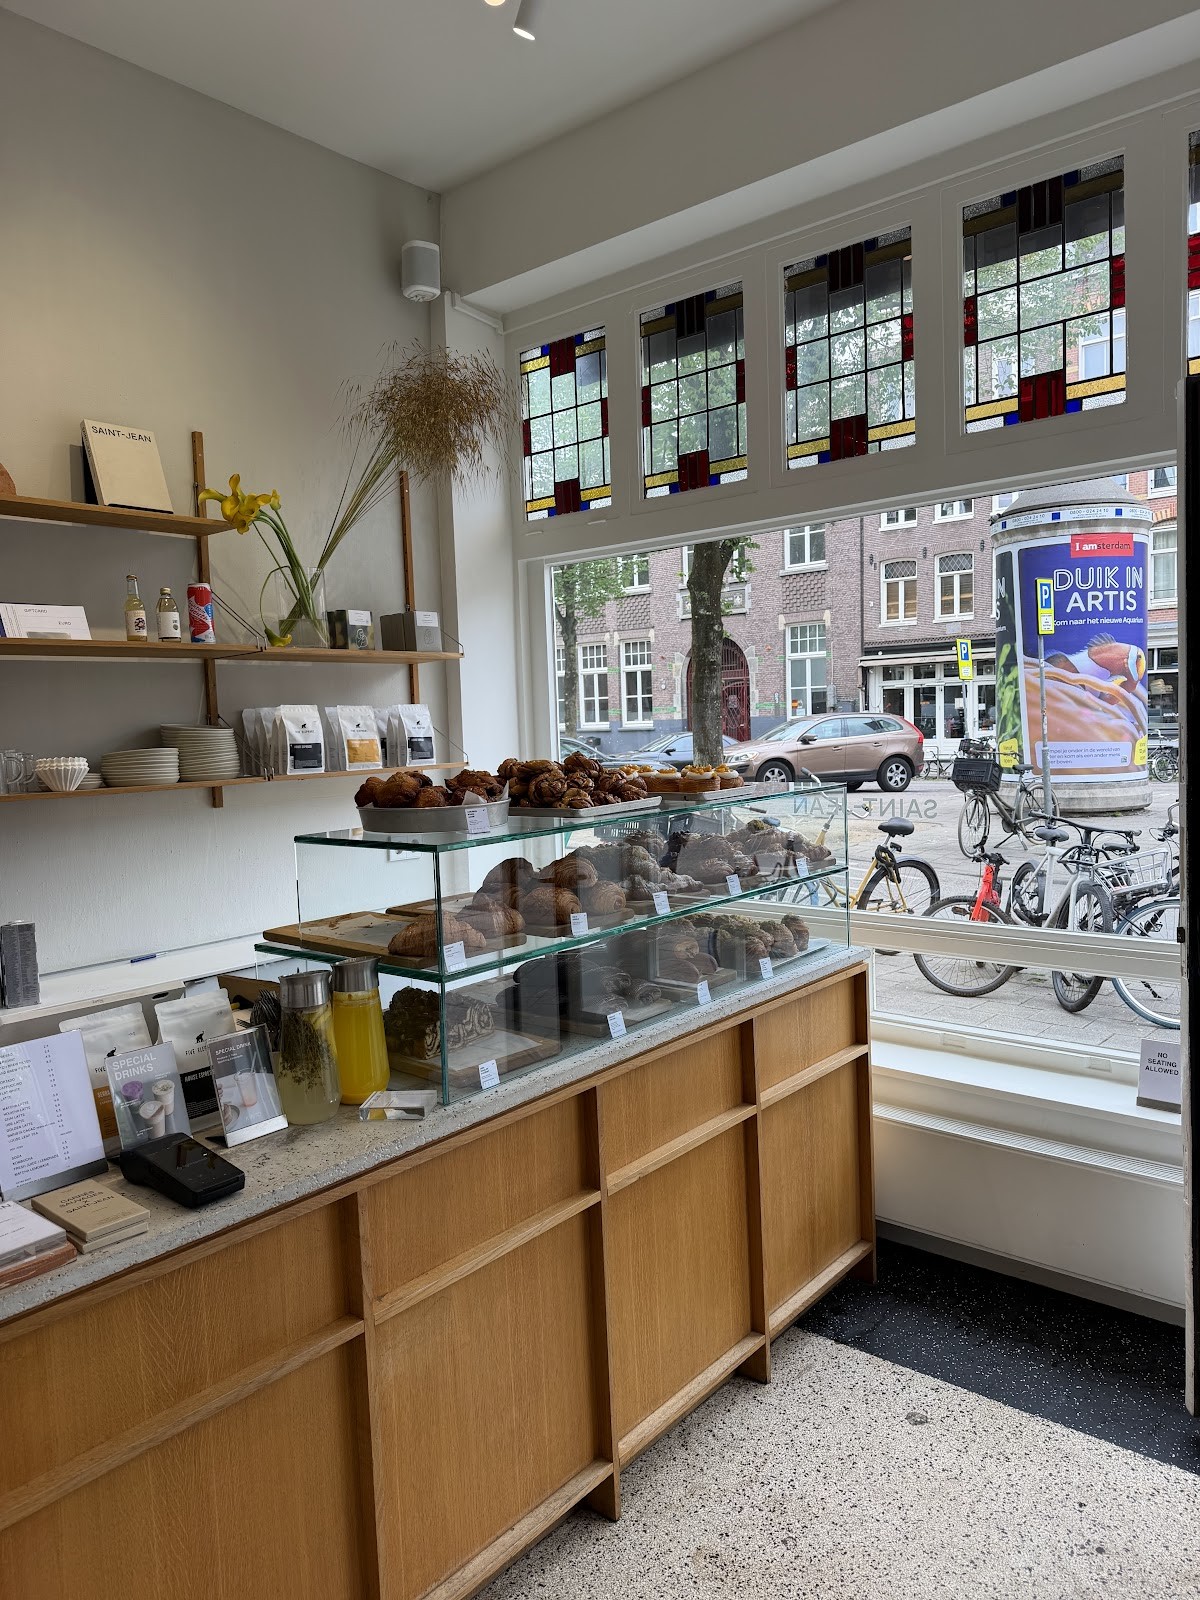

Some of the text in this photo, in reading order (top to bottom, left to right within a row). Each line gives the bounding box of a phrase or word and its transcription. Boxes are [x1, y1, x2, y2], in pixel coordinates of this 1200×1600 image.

[92, 425, 152, 442] SAINT-JEAN
[1075, 542, 1131, 551] I amsterdam
[1054, 566, 1143, 591] DUIK IN
[1042, 586, 1049, 603] P
[1066, 590, 1137, 613] ARTIS
[961, 643, 968, 659] P
[112, 1052, 156, 1070] SPECIAL
[1148, 1058, 1177, 1068] SEATING
[114, 1063, 154, 1080] DRINKS
[1145, 1065, 1179, 1075] ALLOWED
[0, 1082, 22, 1090] APPUCCINO
[66, 1195, 114, 1213] SAINT-JEAN
